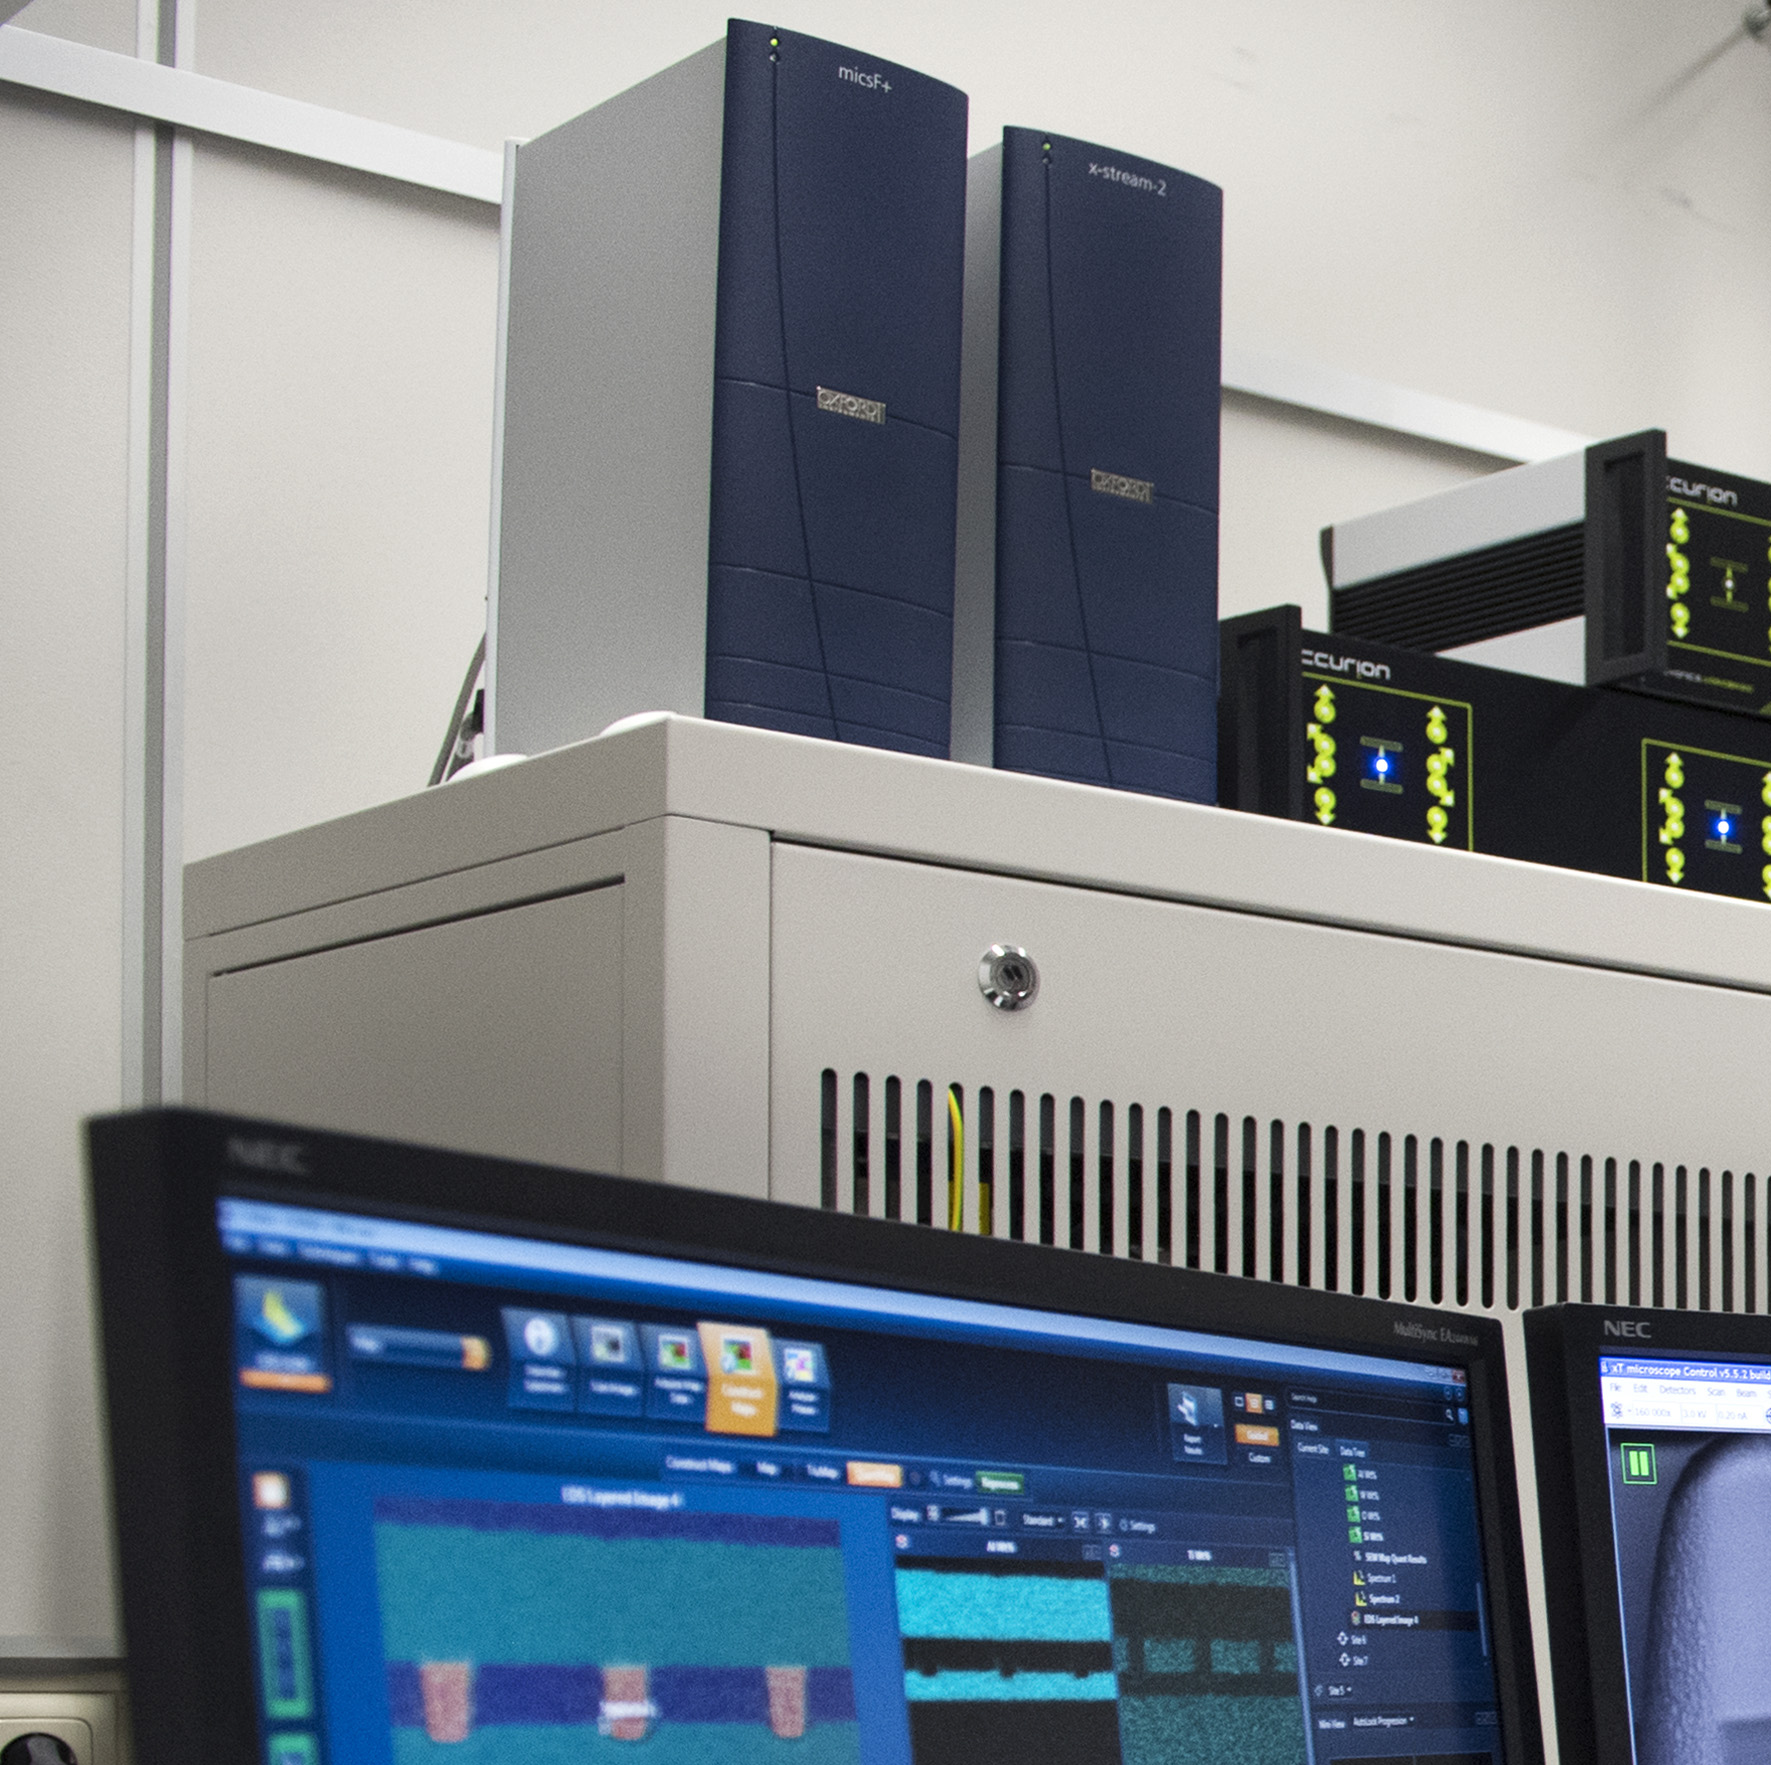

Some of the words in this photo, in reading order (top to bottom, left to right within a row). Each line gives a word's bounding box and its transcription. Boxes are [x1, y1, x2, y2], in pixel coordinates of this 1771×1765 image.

[839, 64, 893, 94] micsF+
[1088, 161, 1167, 196] x-stream-2
[1604, 1320, 1651, 1338] NEC
[1611, 1364, 1625, 1374] xT
[1627, 1366, 1681, 1379] microscope
[1684, 1367, 1717, 1378] Control
[1719, 1369, 1748, 1380] v5.5.2
[1750, 1370, 1771, 1381] build
[1610, 1383, 1621, 1392] File
[1633, 1384, 1647, 1394] Edit
[1660, 1385, 1696, 1396] Detectors
[1707, 1387, 1726, 1398] Scan
[1736, 1389, 1757, 1399] Beam
[1297, 1442, 1318, 1454] Current
